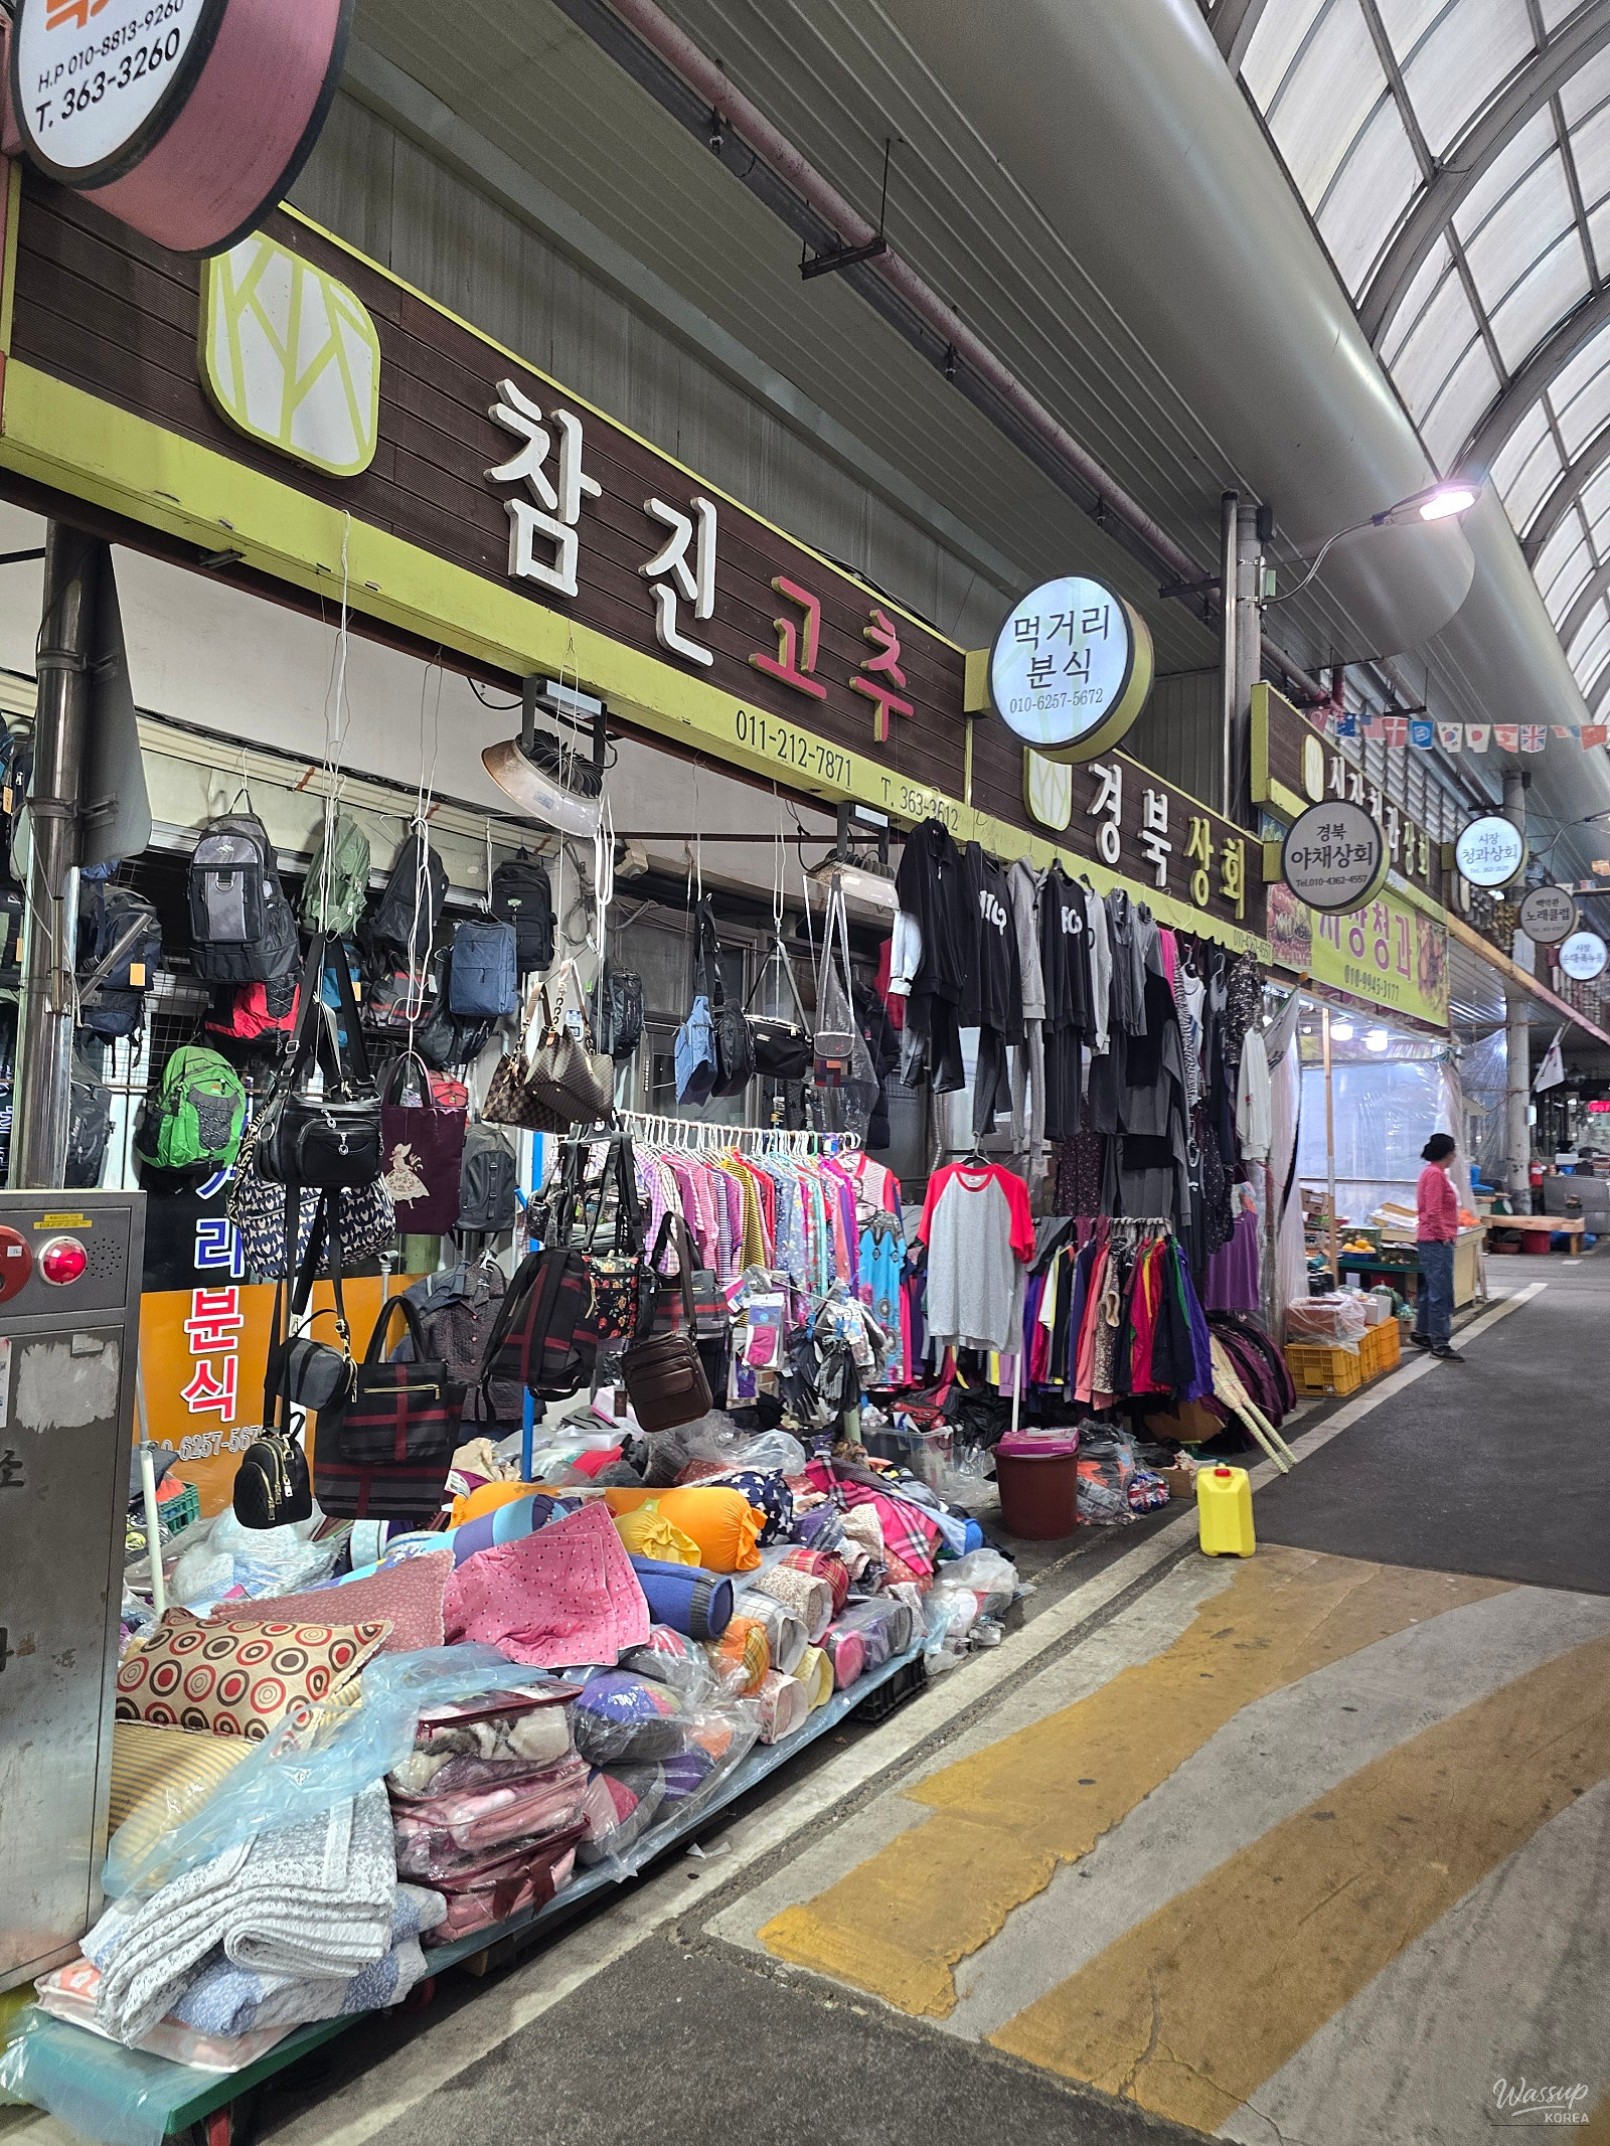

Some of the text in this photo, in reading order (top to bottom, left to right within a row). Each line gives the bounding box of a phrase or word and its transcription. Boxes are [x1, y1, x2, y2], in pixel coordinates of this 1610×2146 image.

[68, 0, 184, 76] 010-8813-9260
[36, 27, 180, 133] T. 363-3260
[1014, 605, 1110, 651] 먹거리
[1026, 648, 1091, 690] 분식
[1009, 688, 1104, 714] 010-6257-5672
[736, 710, 852, 788] 011-212-7871
[881, 776, 895, 808] T.
[1316, 823, 1347, 842] 경북
[1478, 832, 1500, 845] 시장
[1291, 841, 1373, 871] 야채상회
[1462, 844, 1518, 865] 청과상회
[1525, 907, 1570, 922] 노래클럽
[181, 1285, 243, 1423] 분식
